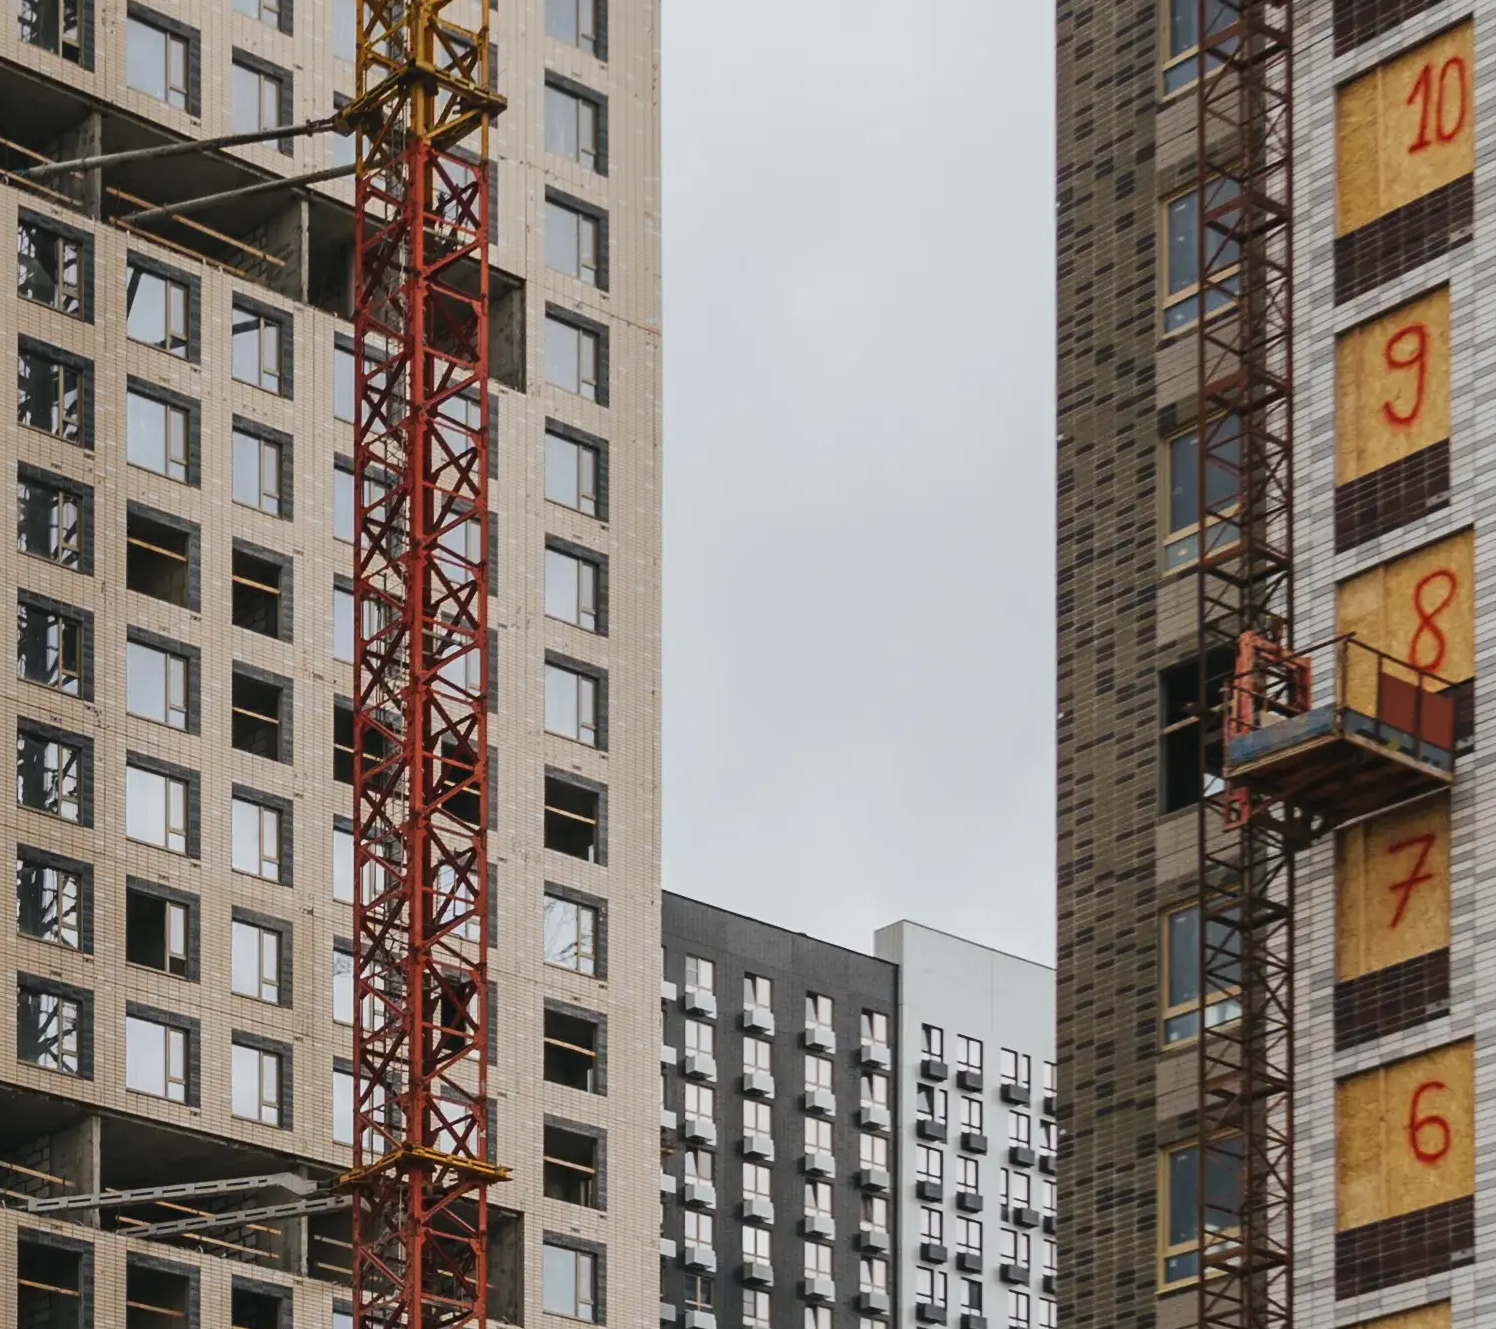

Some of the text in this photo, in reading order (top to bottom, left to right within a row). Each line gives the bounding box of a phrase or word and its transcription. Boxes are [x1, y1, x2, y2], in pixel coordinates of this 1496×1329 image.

[1407, 56, 1467, 155] 10
[1383, 325, 1428, 427] 9
[1410, 569, 1458, 672] 8
[1387, 832, 1437, 930] 7
[1409, 1080, 1451, 1164] 6
